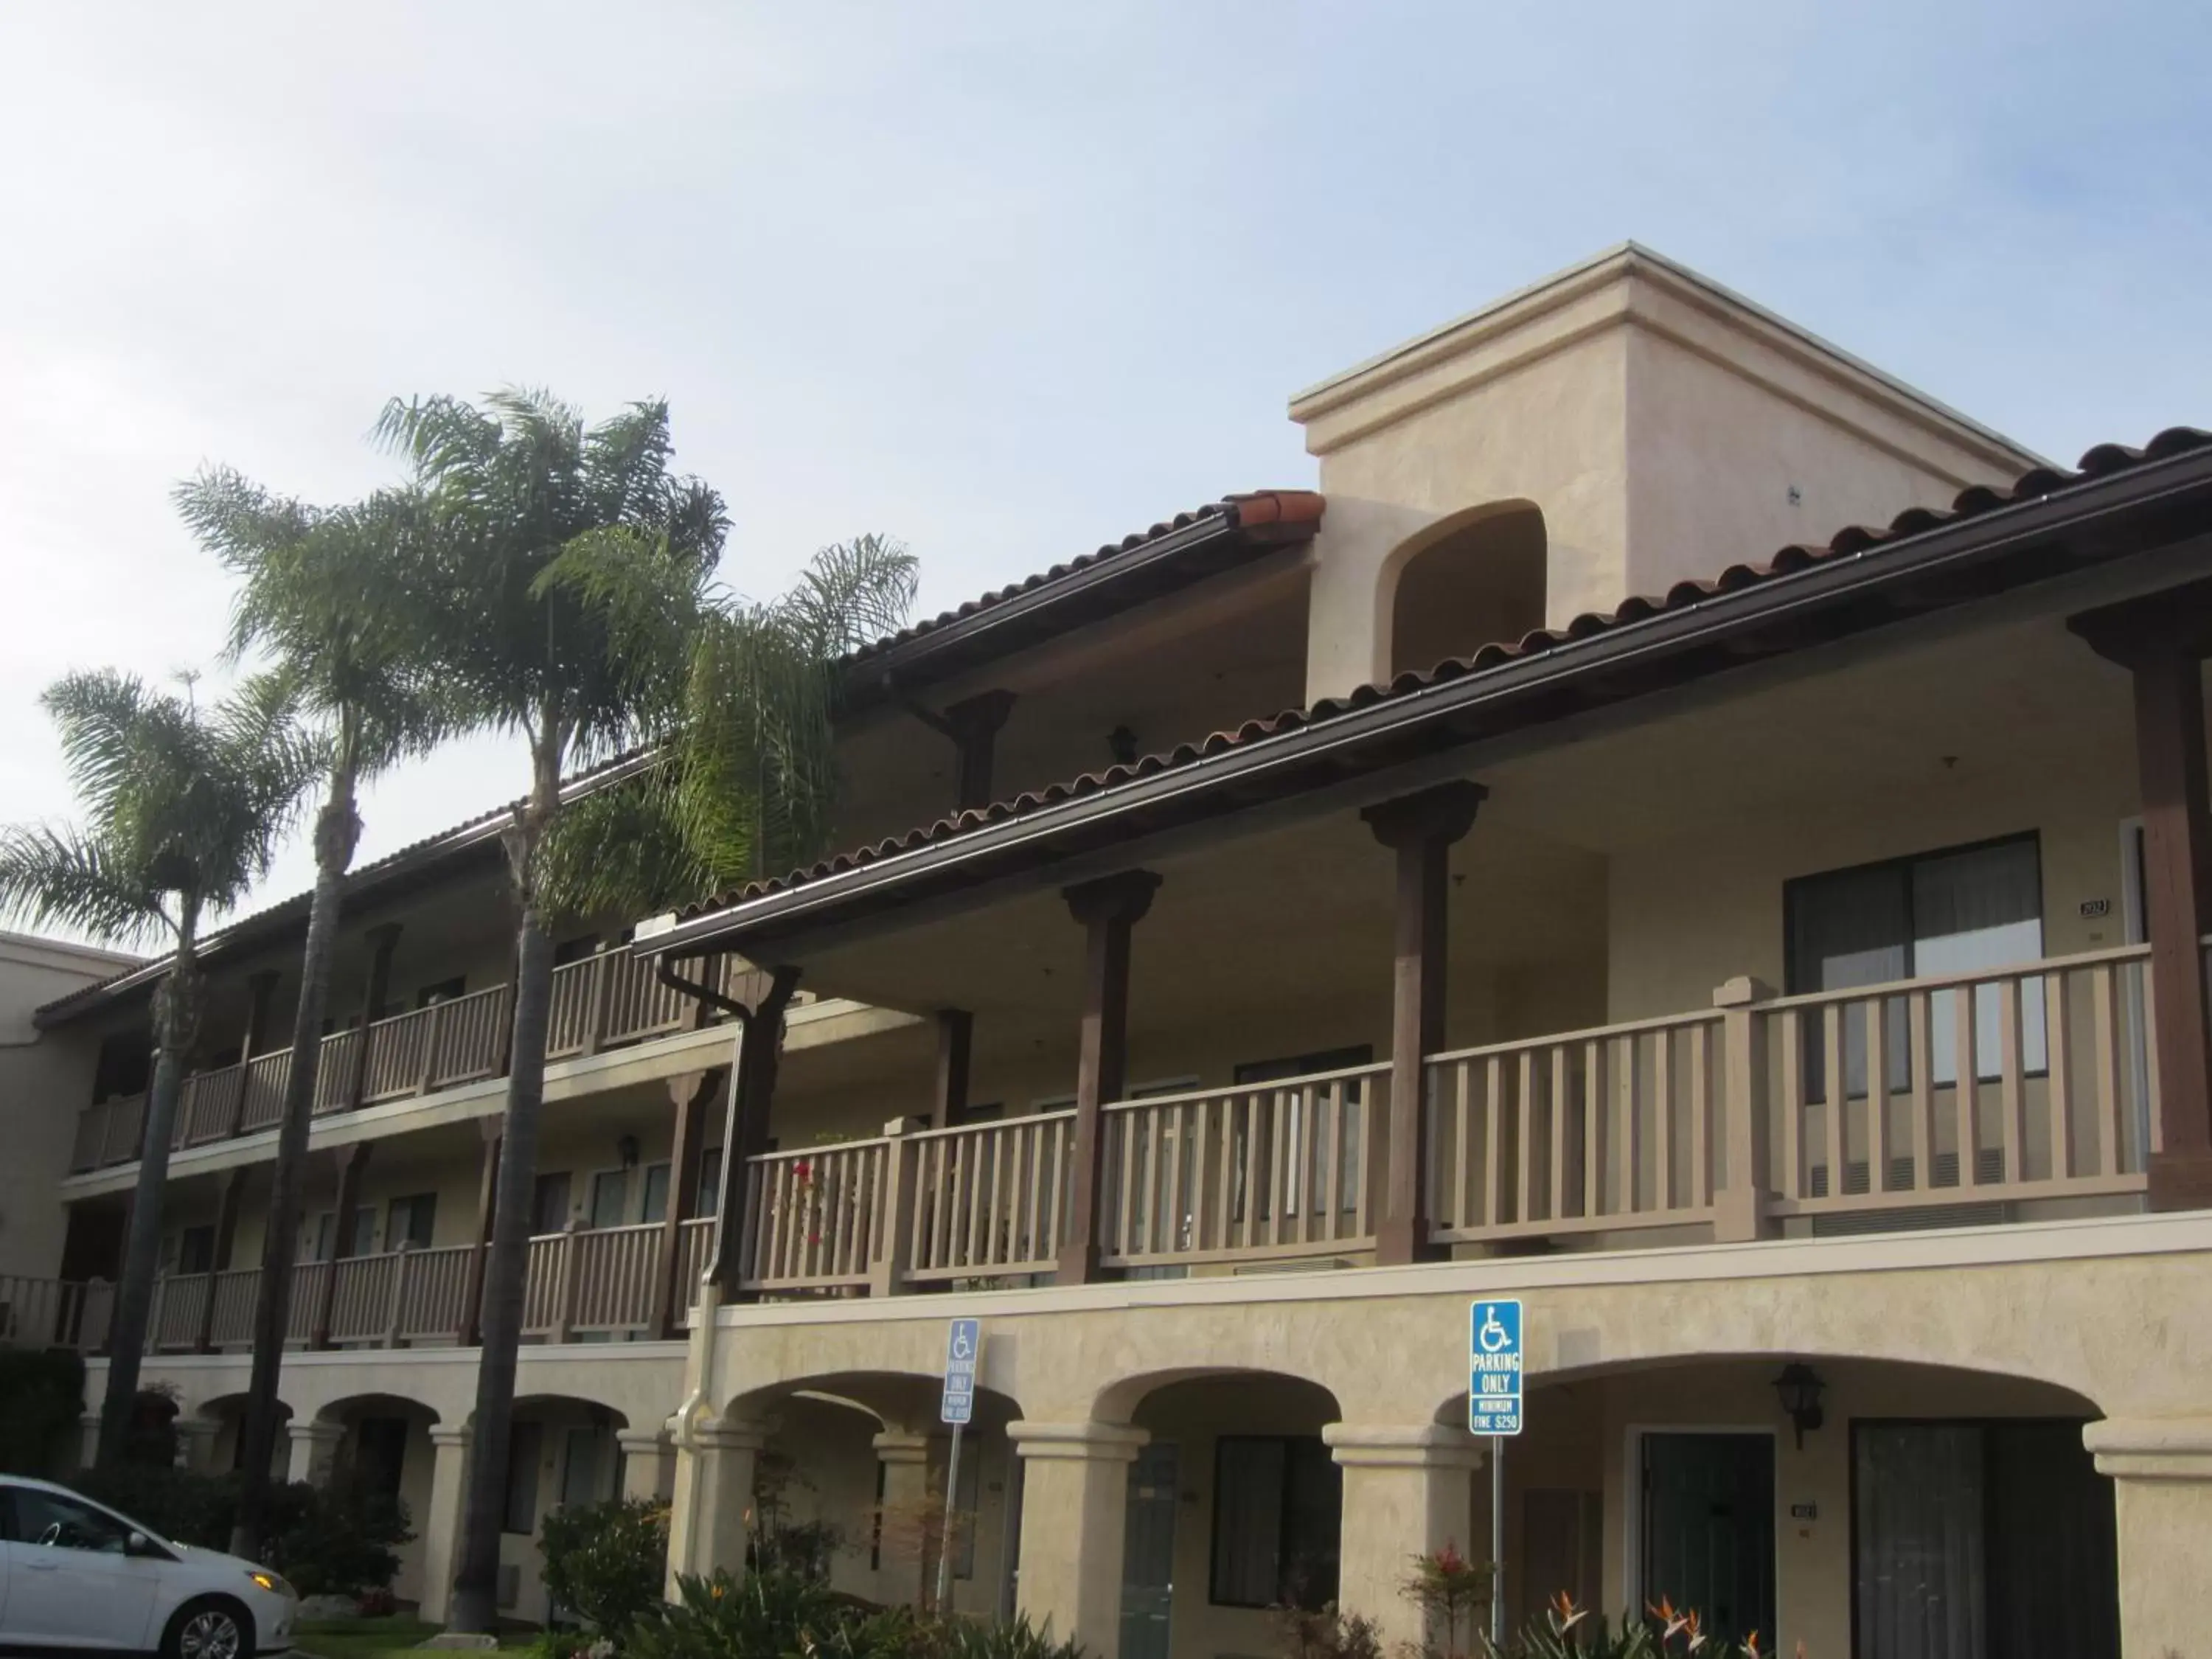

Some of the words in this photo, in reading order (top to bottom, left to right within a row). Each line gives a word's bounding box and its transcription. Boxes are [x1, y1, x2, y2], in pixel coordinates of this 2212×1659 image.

[1473, 1353, 1519, 1371] PARKING
[1481, 1374, 1510, 1393] ONLY
[1475, 1415, 1491, 1428] FINE
[1495, 1415, 1517, 1428] $250
